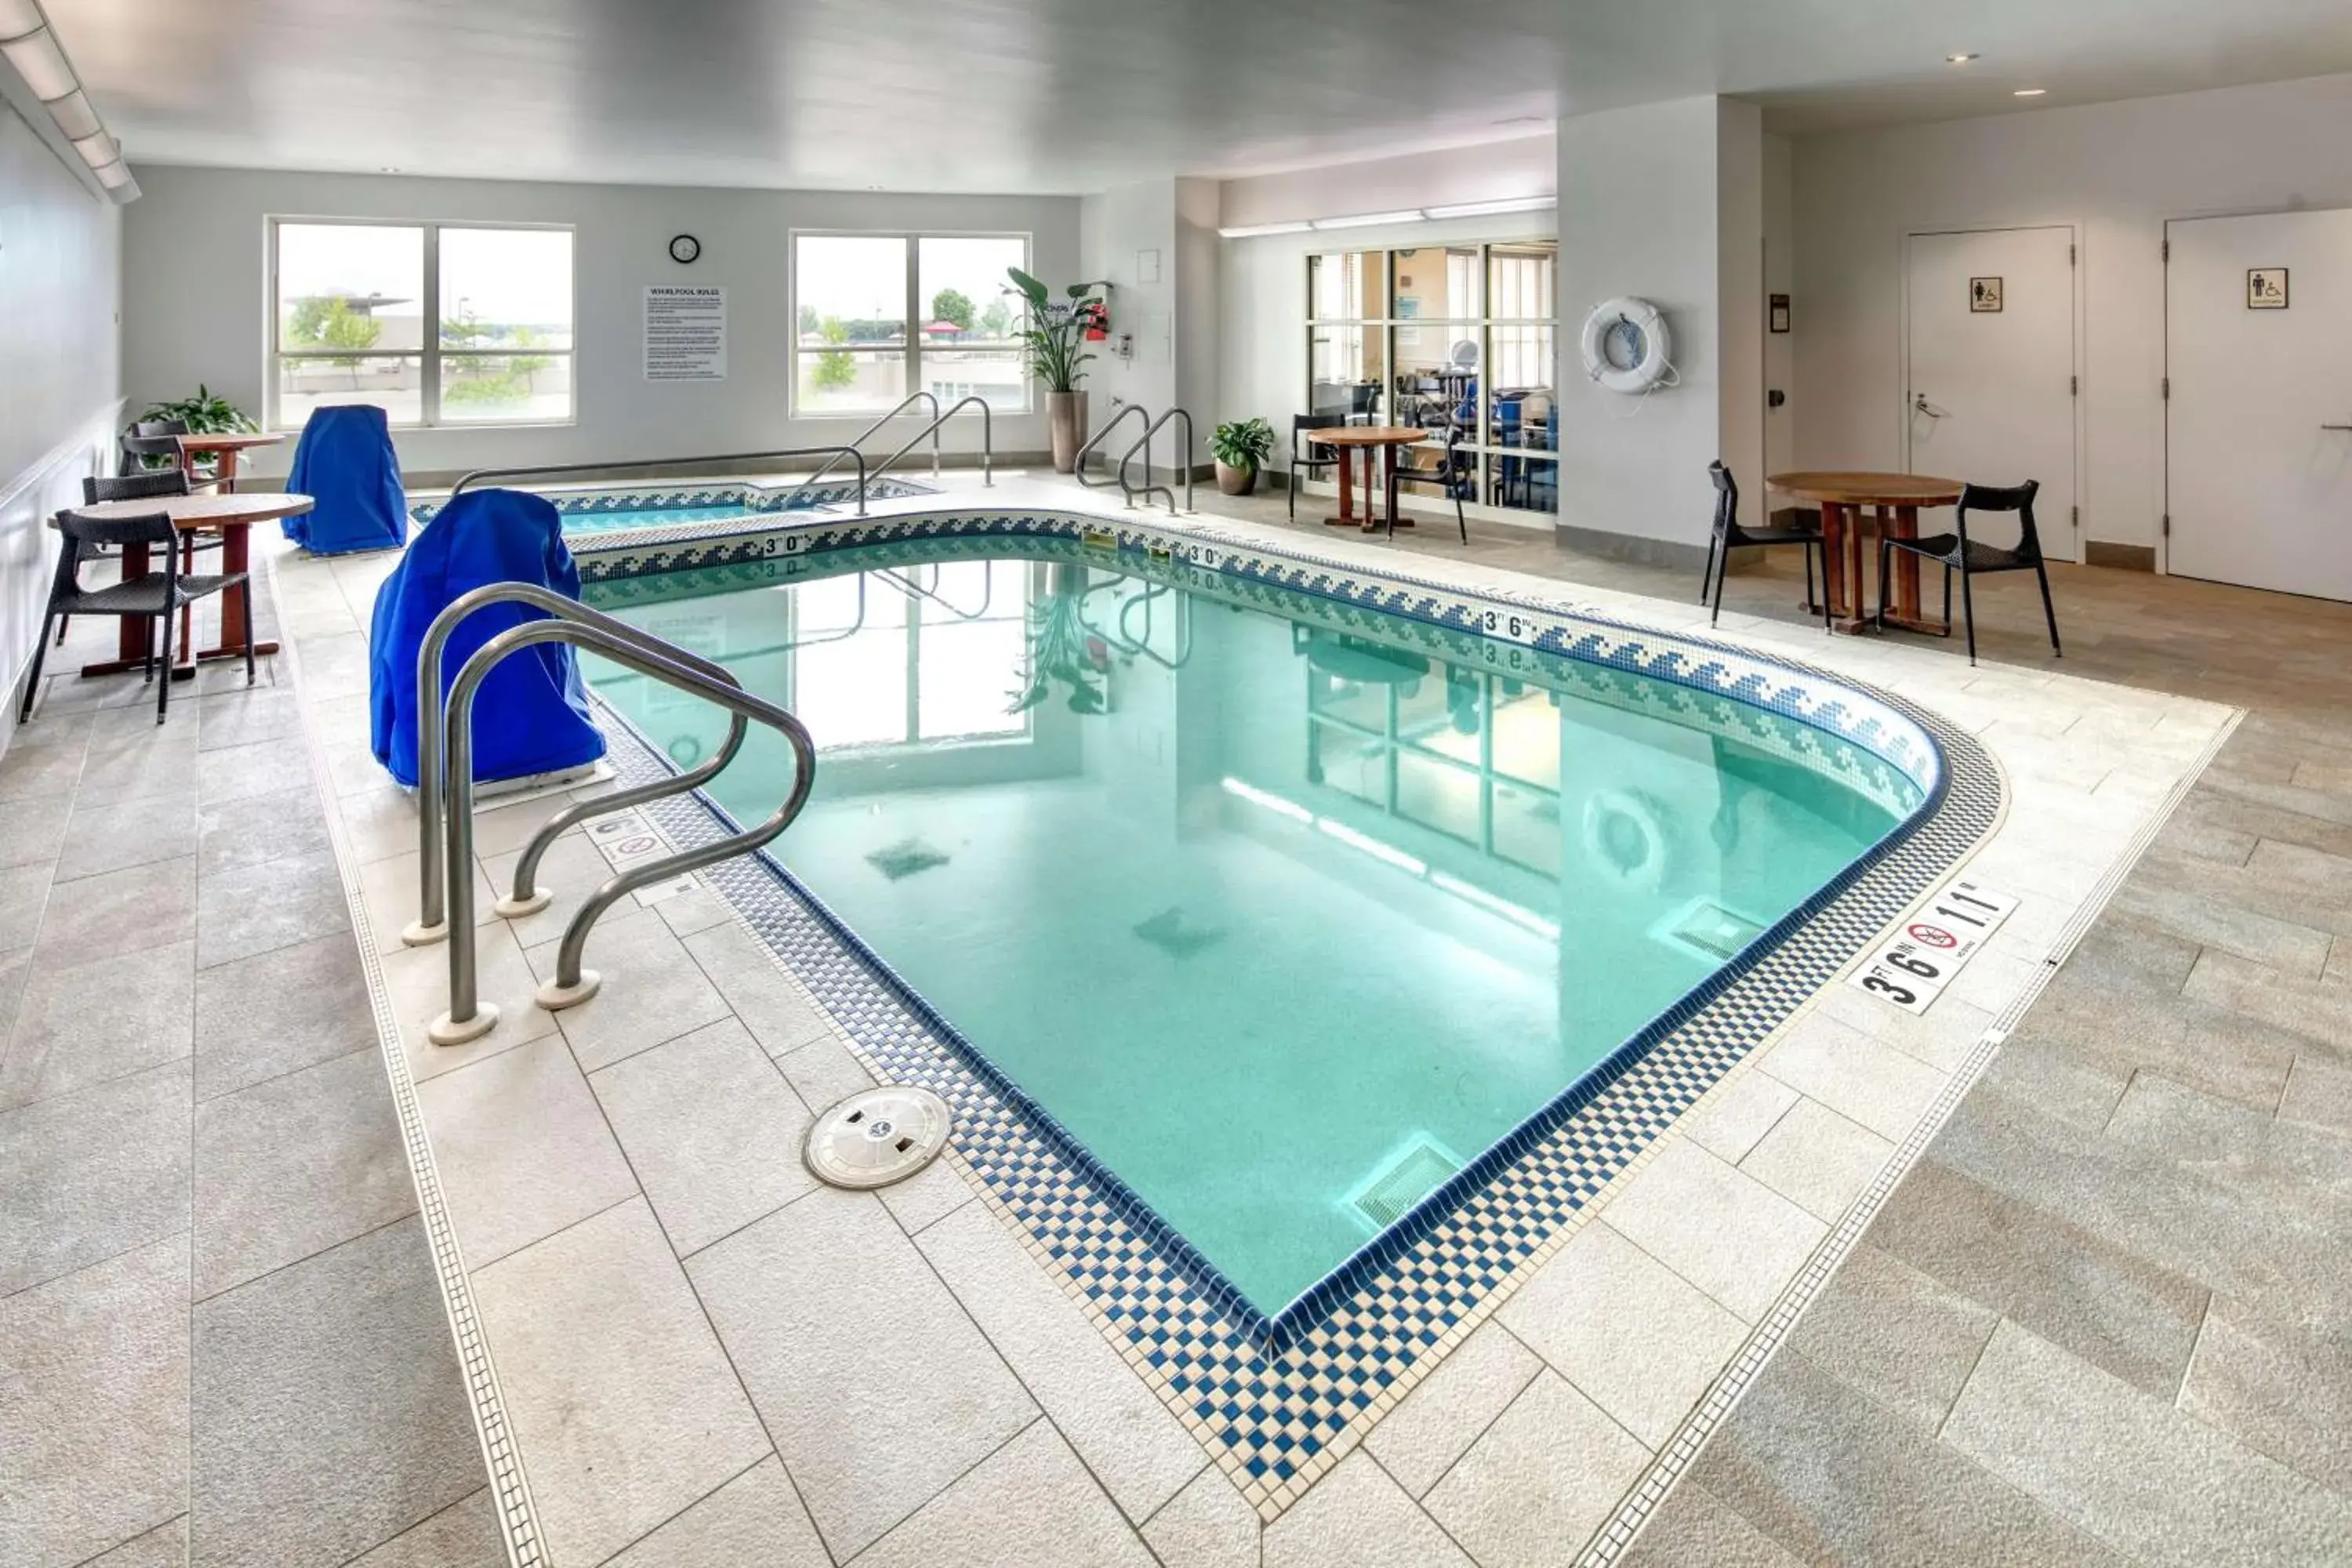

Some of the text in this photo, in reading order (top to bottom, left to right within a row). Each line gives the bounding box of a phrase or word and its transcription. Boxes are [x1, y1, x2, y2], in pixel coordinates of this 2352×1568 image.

[766, 535, 797, 553] 3 0
[1191, 545, 1214, 564] 3 0
[1485, 611, 1497, 631] 3
[1509, 616, 1522, 637] 6
[1871, 965, 1893, 979] FT
[1886, 953, 1940, 978] 6
[1862, 976, 1917, 1004] 3
